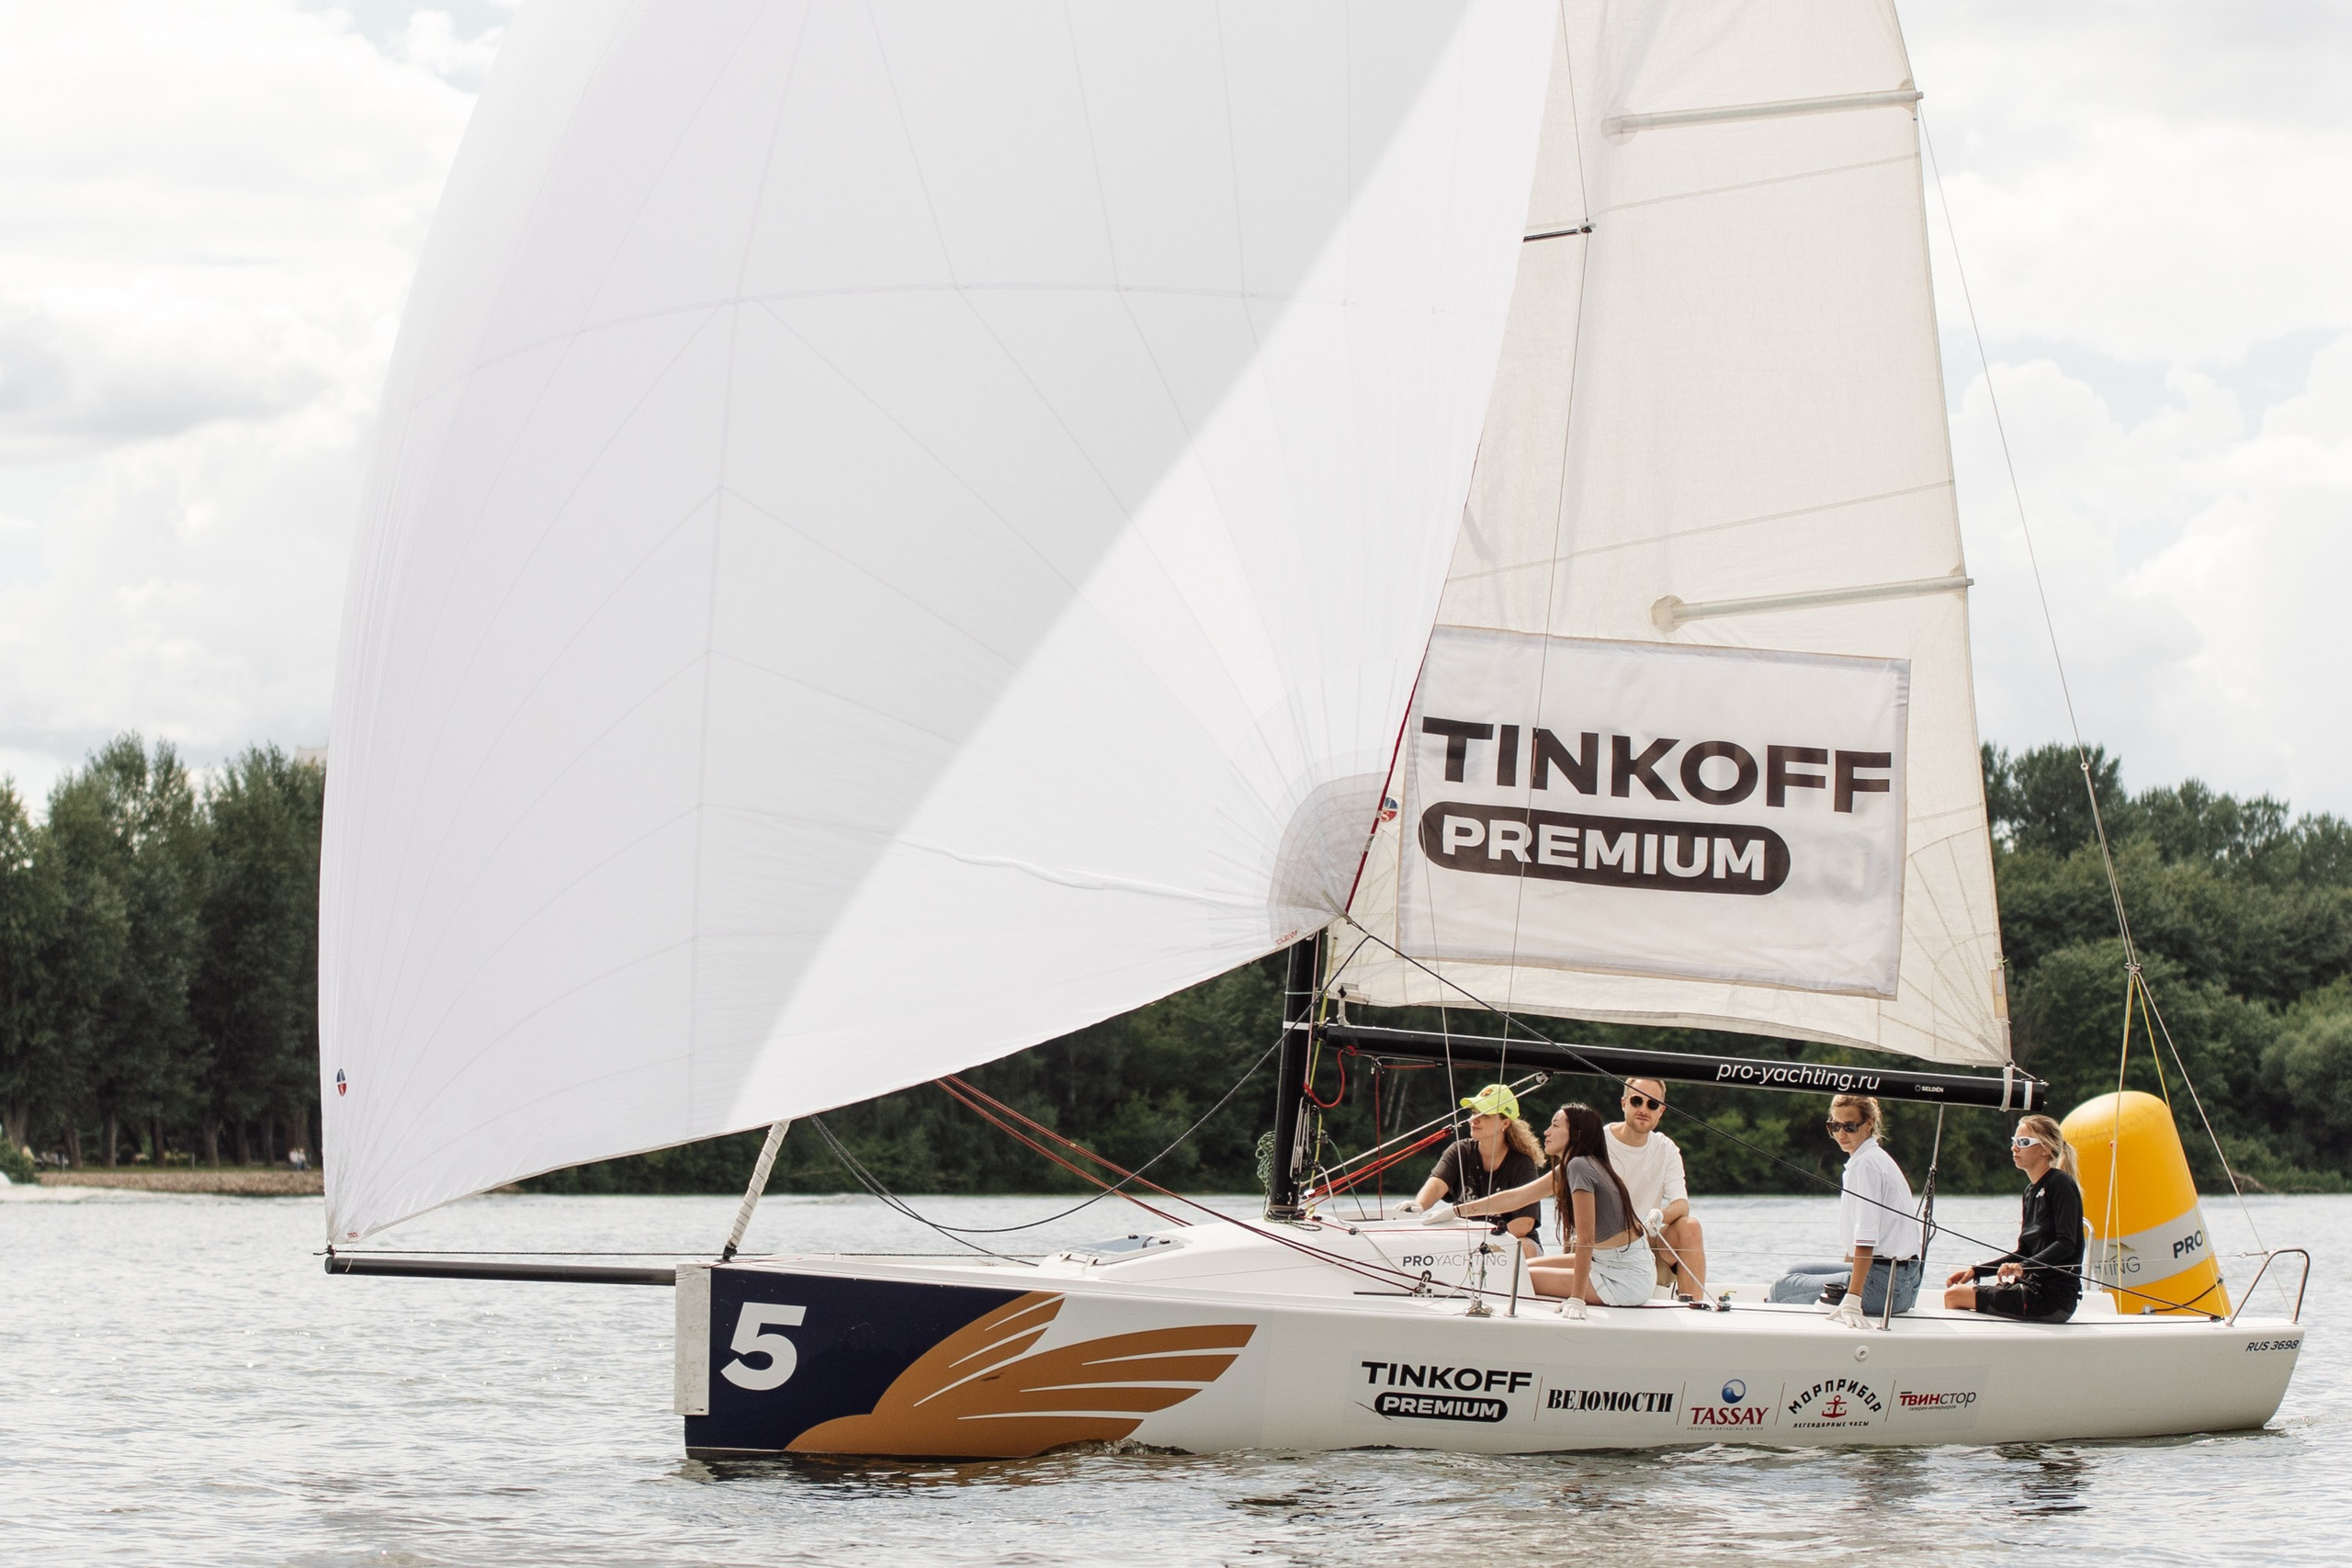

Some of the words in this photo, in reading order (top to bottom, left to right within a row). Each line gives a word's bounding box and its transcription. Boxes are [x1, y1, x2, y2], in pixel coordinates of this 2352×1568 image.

[1421, 716, 1893, 813] TINKOFF
[1442, 815, 1766, 882] PREMIUM
[1716, 1063, 1881, 1091] pro-yachting.ru
[1402, 1254, 1508, 1268] PROYACHTNG
[720, 1302, 807, 1391] 5
[2245, 1341, 2270, 1351] RUS
[2270, 1339, 2300, 1350] 3698
[1362, 1360, 1532, 1393] TINKOFF
[1382, 1395, 1500, 1418] PREMIUM
[1546, 1388, 1675, 1414] ВЕДОМОСТИ
[1788, 1379, 1882, 1415] МОРПРИБОР
[1690, 1406, 1770, 1425] TASSAY
